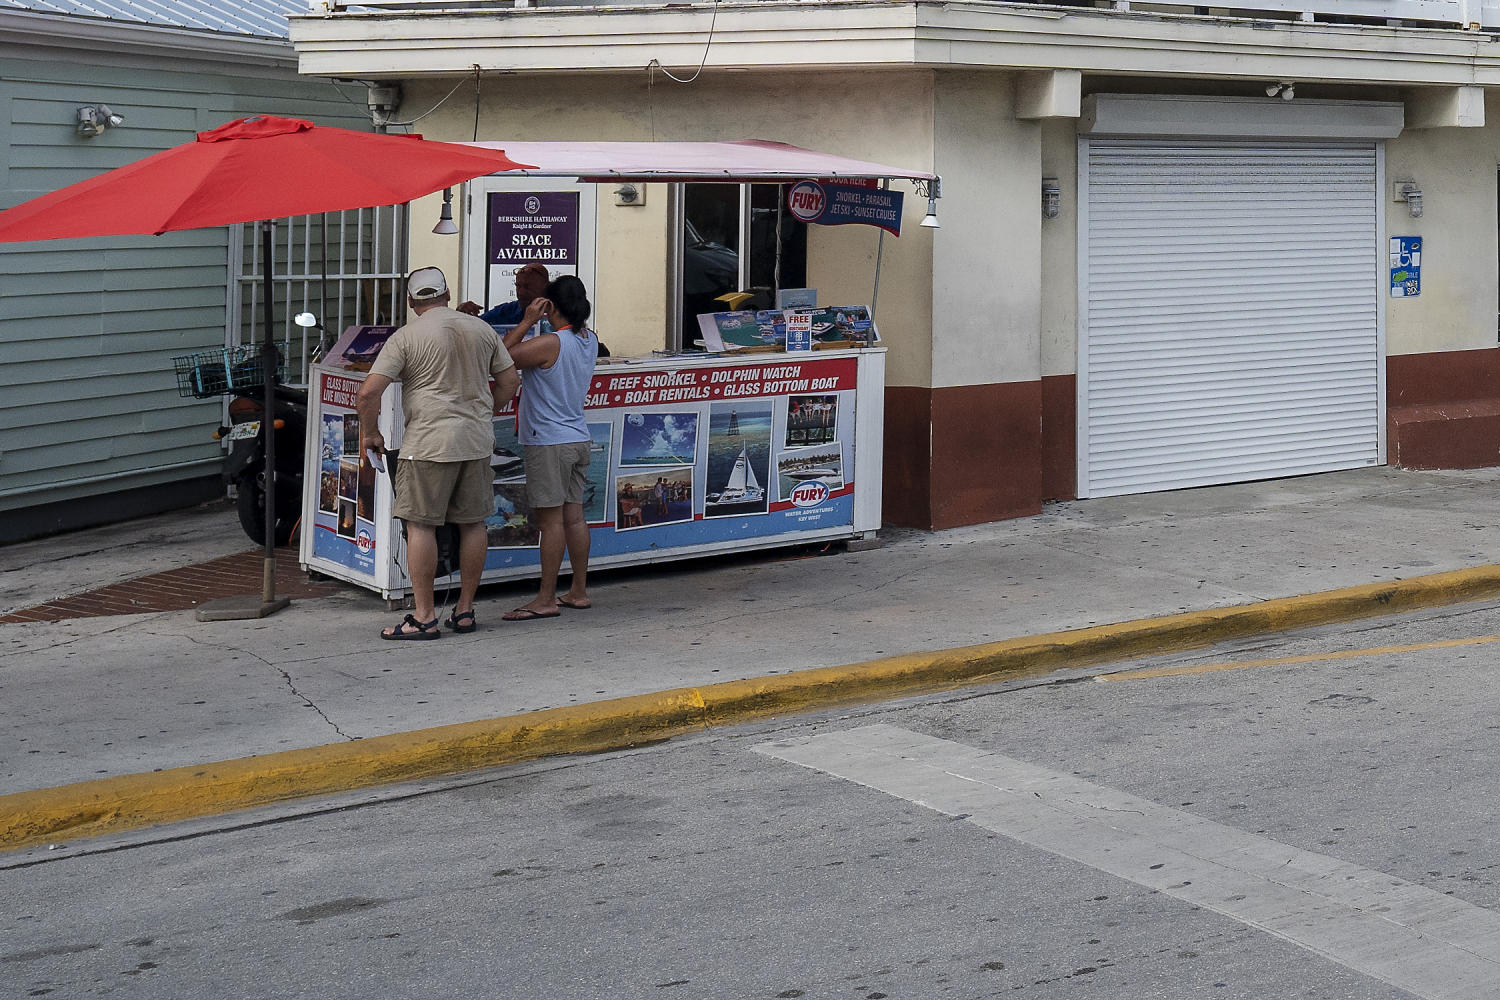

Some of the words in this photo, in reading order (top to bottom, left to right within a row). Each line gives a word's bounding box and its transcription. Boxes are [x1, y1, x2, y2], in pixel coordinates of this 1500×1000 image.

[792, 192, 823, 210] FURY
[836, 192, 862, 203] SNORKEL
[866, 194, 892, 207] PARASAIL
[831, 205, 840, 214] JET
[841, 205, 851, 216] SKI
[854, 206, 876, 219] SUNSET
[876, 208, 896, 220] CRUISE
[512, 234, 551, 245] SPACE
[497, 248, 568, 259] AVAILABLE
[789, 315, 809, 324] FREE
[327, 376, 341, 390] GLASS
[608, 376, 641, 390] REEF
[642, 373, 697, 388] SNORKEL
[710, 368, 760, 383] DOLPHIN
[762, 366, 801, 379] WATCH
[324, 388, 334, 402] LIVE
[334, 391, 349, 405] MUSIC
[584, 393, 610, 407] SAIL
[624, 390, 657, 404] BOAT
[658, 386, 710, 401] RENTALS
[724, 382, 760, 397] GLASS
[763, 379, 809, 393] BOTTOM
[811, 377, 839, 390] BOAT
[793, 488, 825, 502] FURY
